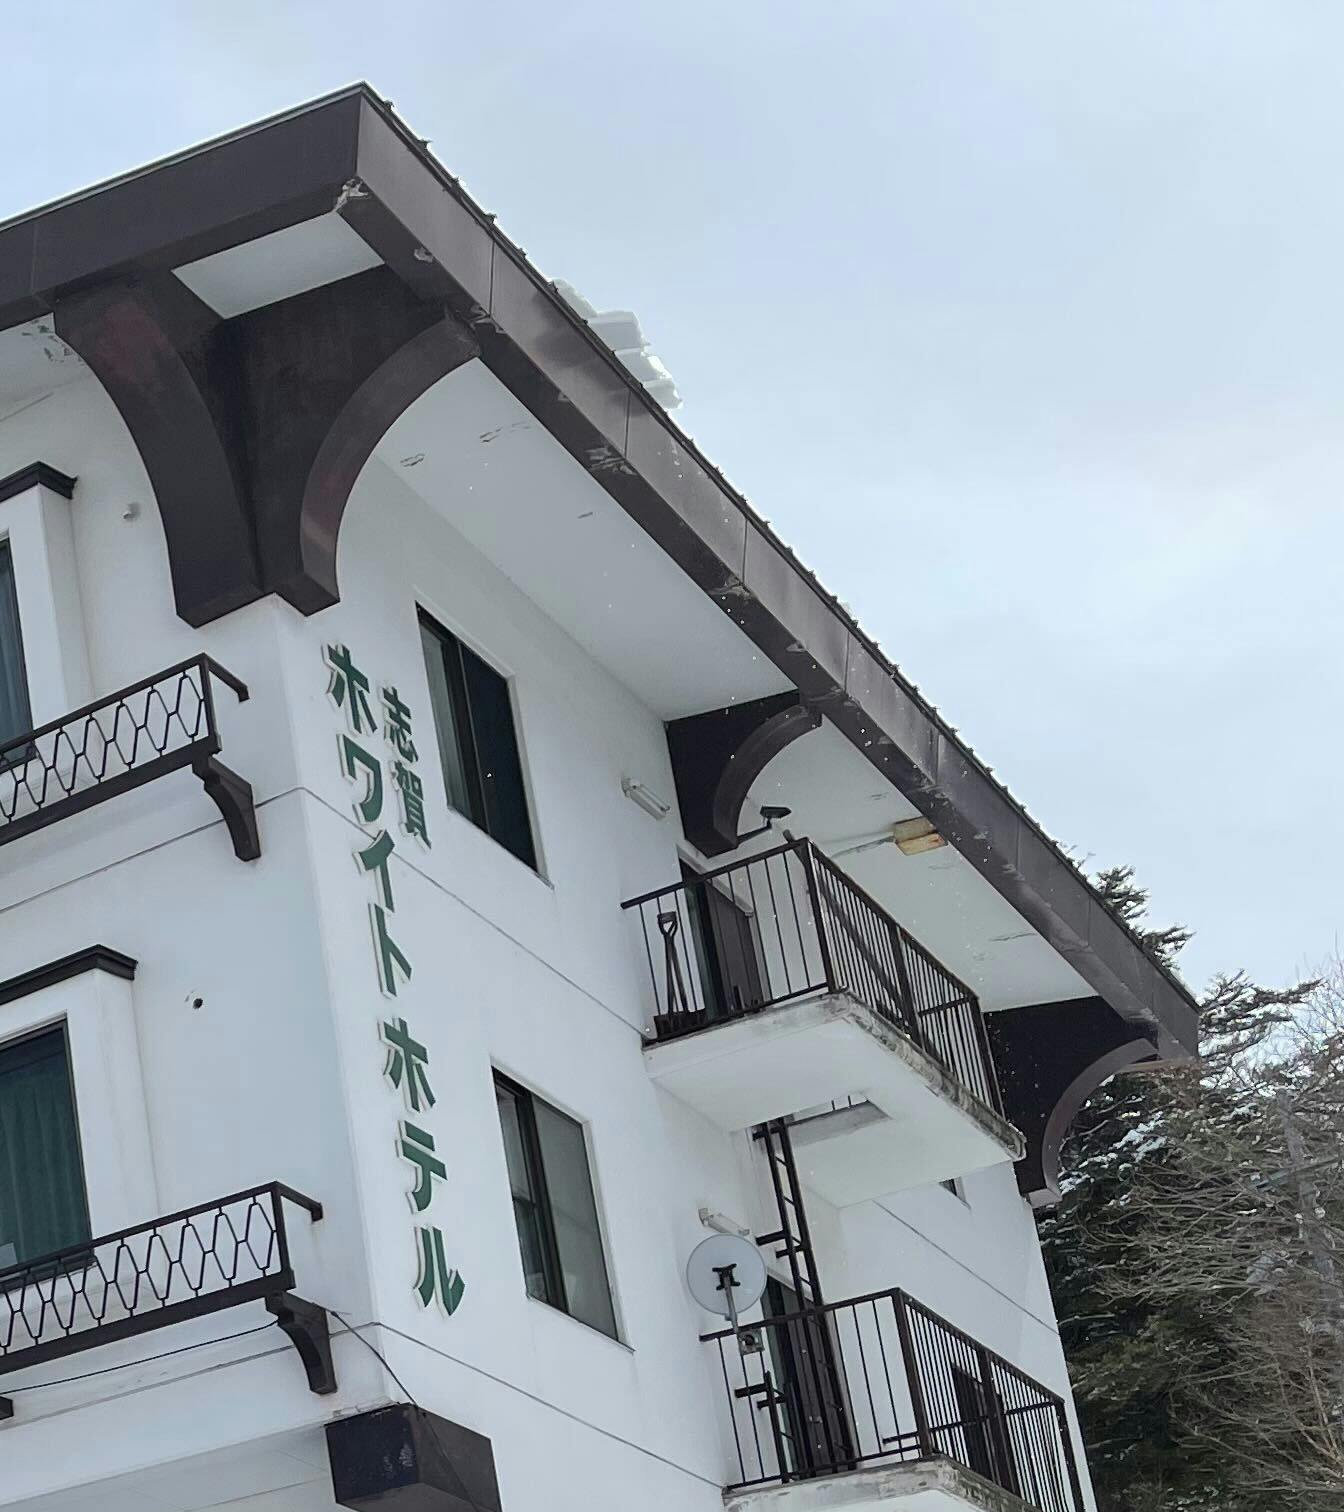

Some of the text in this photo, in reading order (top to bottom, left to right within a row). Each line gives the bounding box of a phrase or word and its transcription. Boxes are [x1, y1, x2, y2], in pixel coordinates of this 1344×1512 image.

[381, 682, 431, 851] 志賀
[323, 642, 466, 1317] ホワイトホテル
